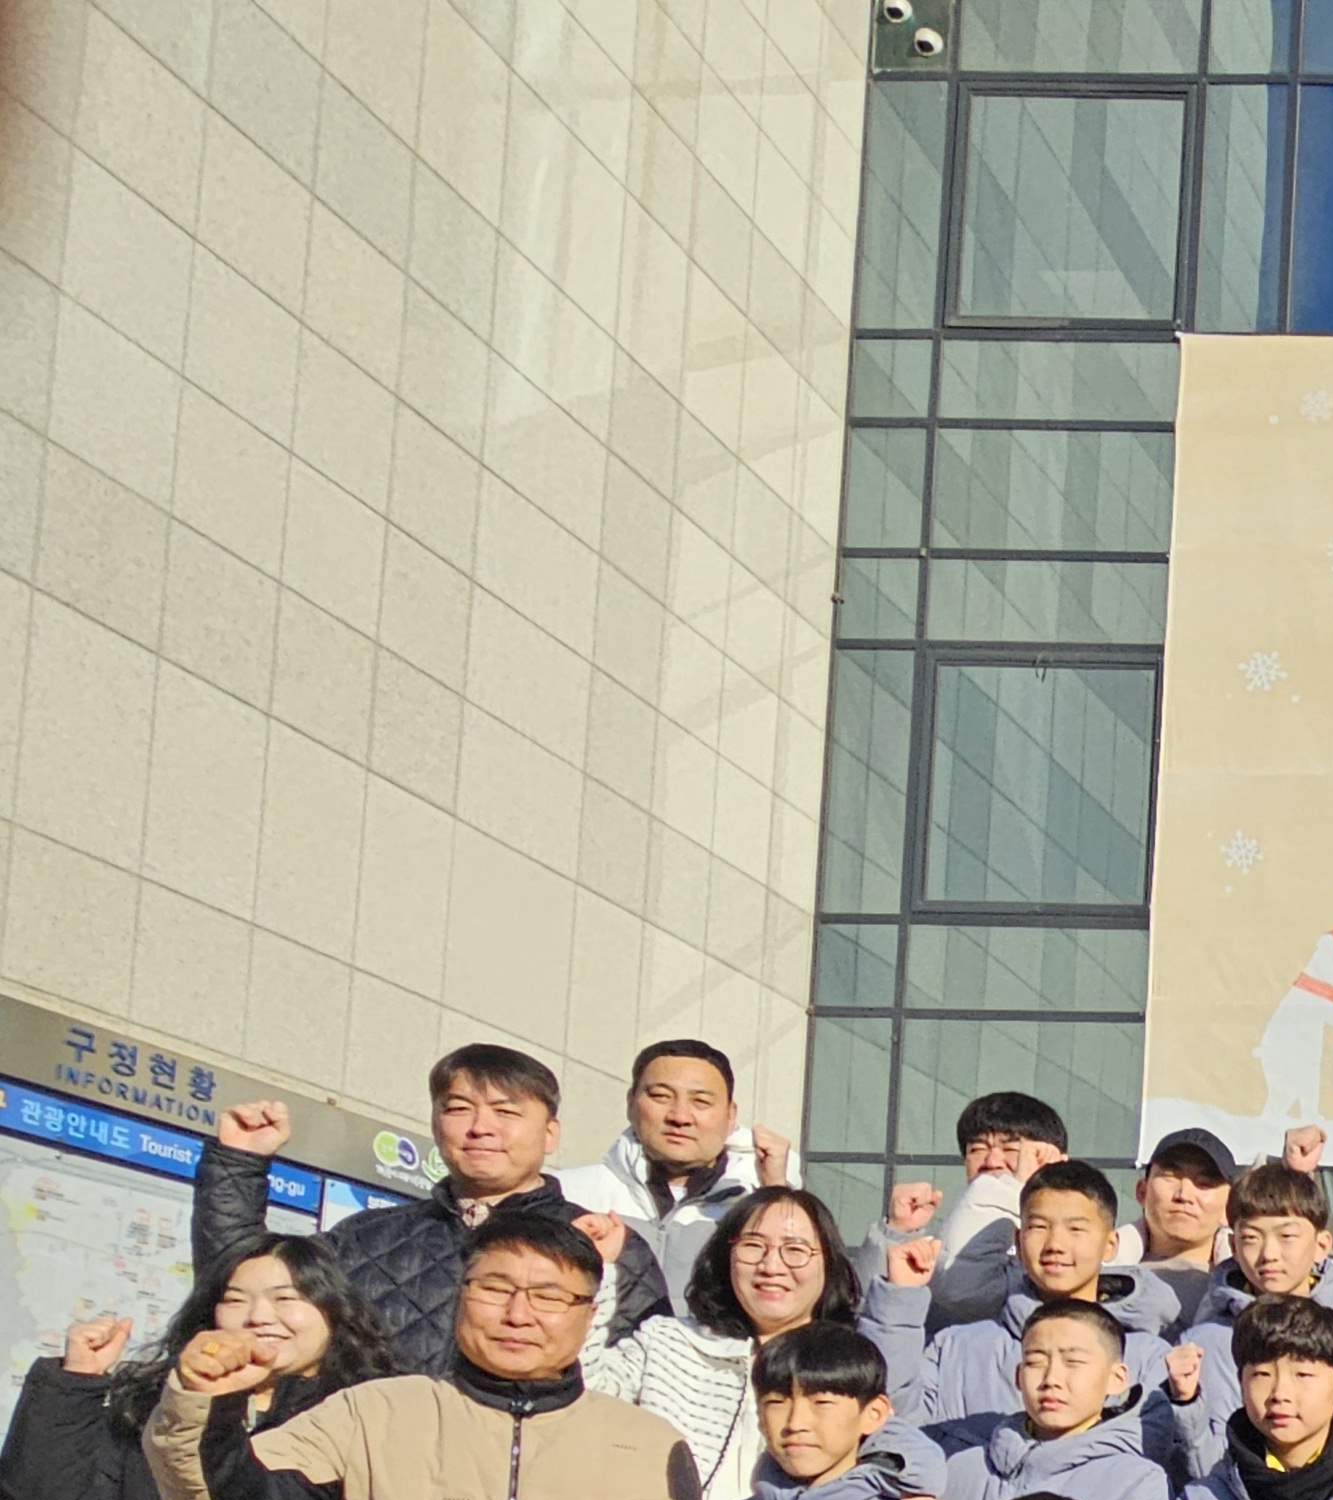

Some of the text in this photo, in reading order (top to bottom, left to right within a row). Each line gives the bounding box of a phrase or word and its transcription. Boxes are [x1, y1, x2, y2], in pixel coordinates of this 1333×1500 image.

[55, 1063, 216, 1126] INFORMATION
[63, 1025, 216, 1102] 구정현황
[20, 1099, 131, 1150] 관광안내도
[139, 1134, 193, 1164] Tourist
